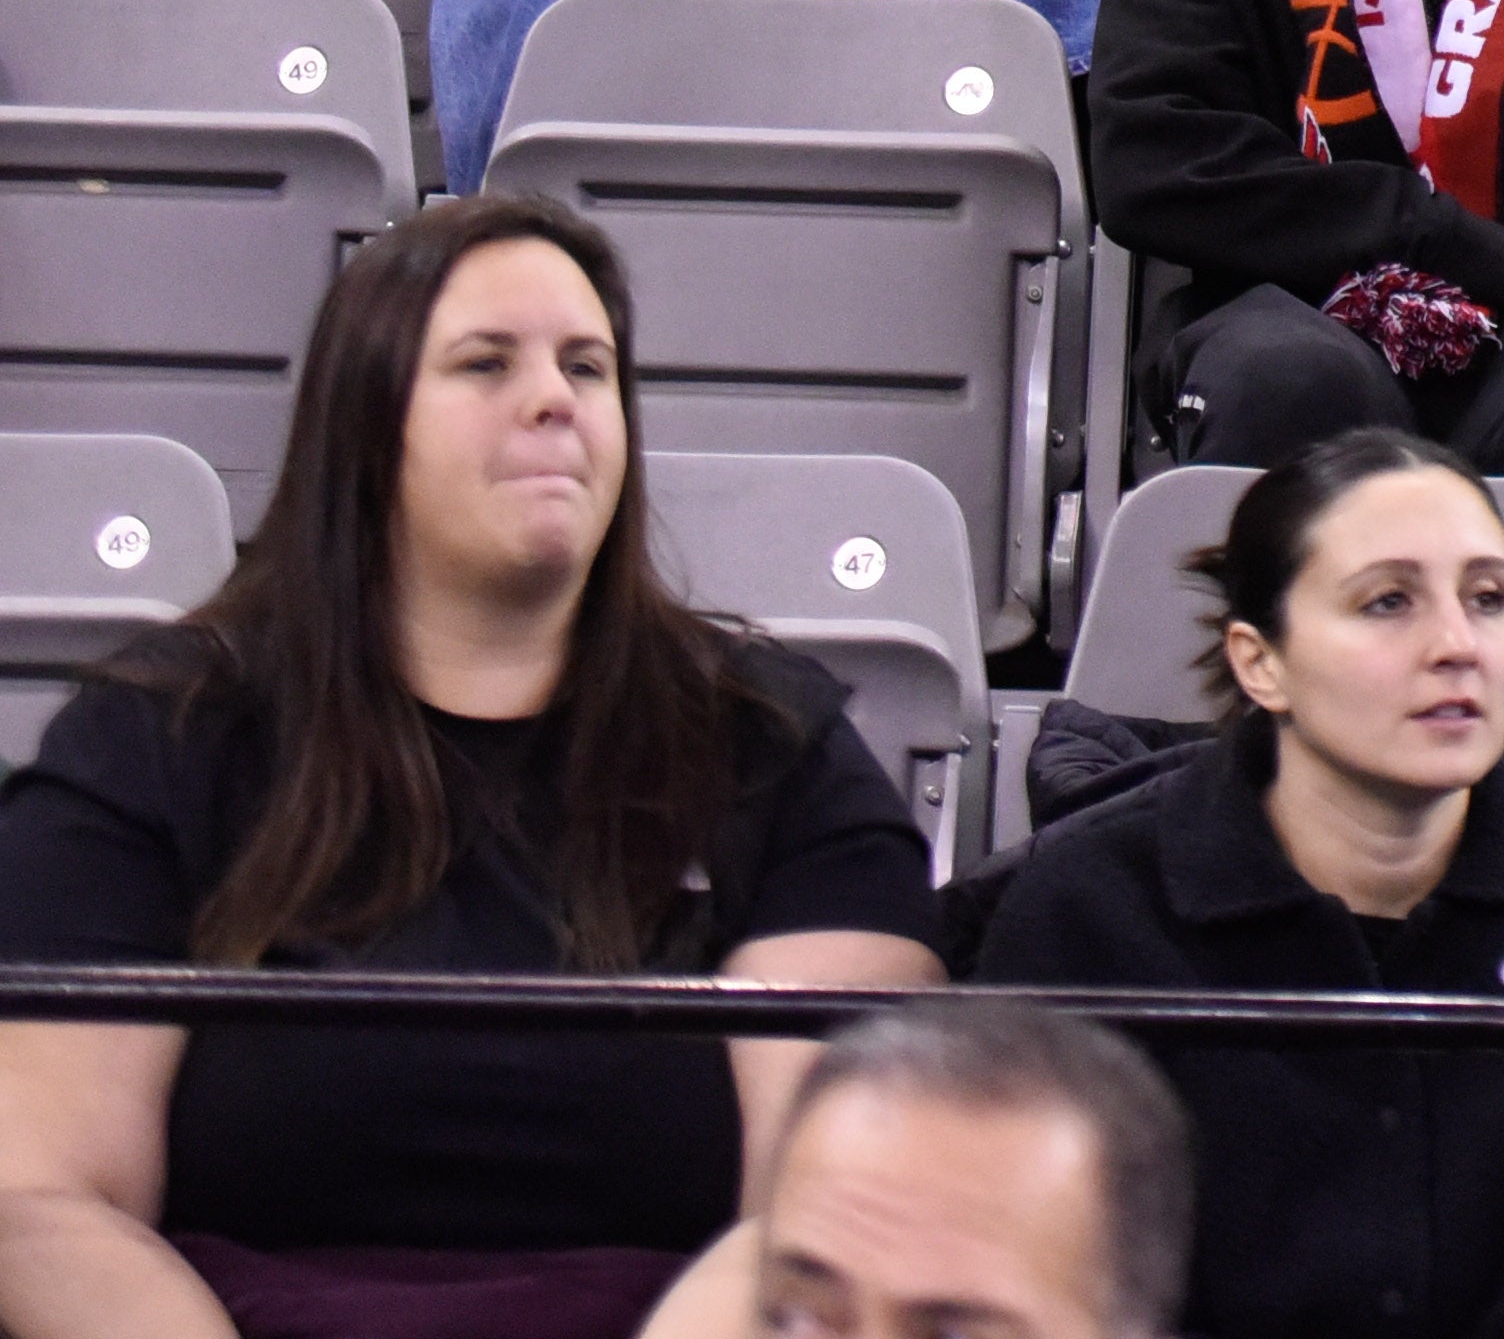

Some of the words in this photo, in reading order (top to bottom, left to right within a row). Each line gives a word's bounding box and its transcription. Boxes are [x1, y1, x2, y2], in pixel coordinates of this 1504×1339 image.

[288, 59, 319, 81] 49
[108, 531, 139, 555] 49
[845, 552, 876, 575] 47
